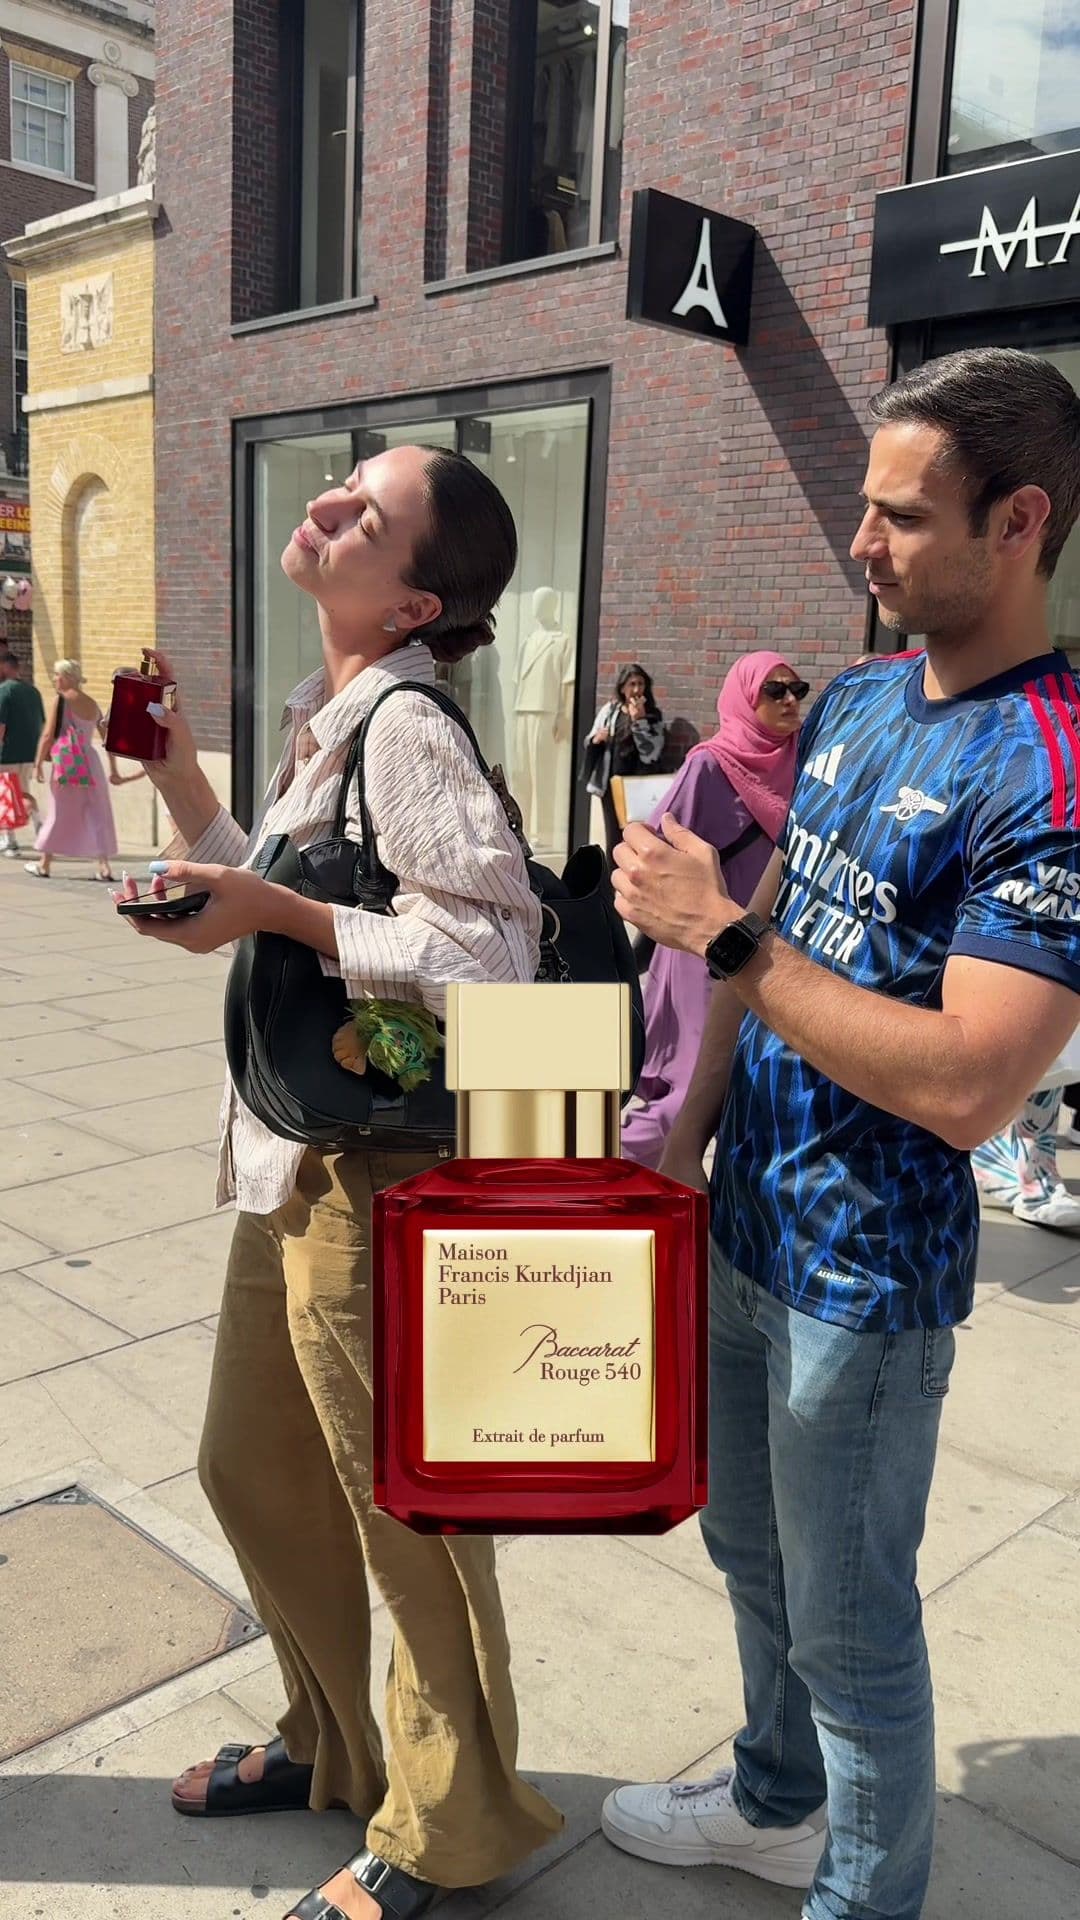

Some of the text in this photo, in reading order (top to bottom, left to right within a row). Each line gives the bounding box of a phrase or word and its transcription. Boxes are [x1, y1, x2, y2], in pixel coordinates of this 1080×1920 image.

[784, 809, 898, 924] mirtes
[1036, 861, 1080, 899] VIS
[439, 1243, 508, 1260] Maison
[438, 1264, 612, 1288] Francis Kurkdjian
[438, 1287, 486, 1304] Paris
[512, 1323, 641, 1374] Baccarat
[540, 1362, 641, 1386] Rouge 540
[472, 1428, 605, 1447] Extrait de parfum
